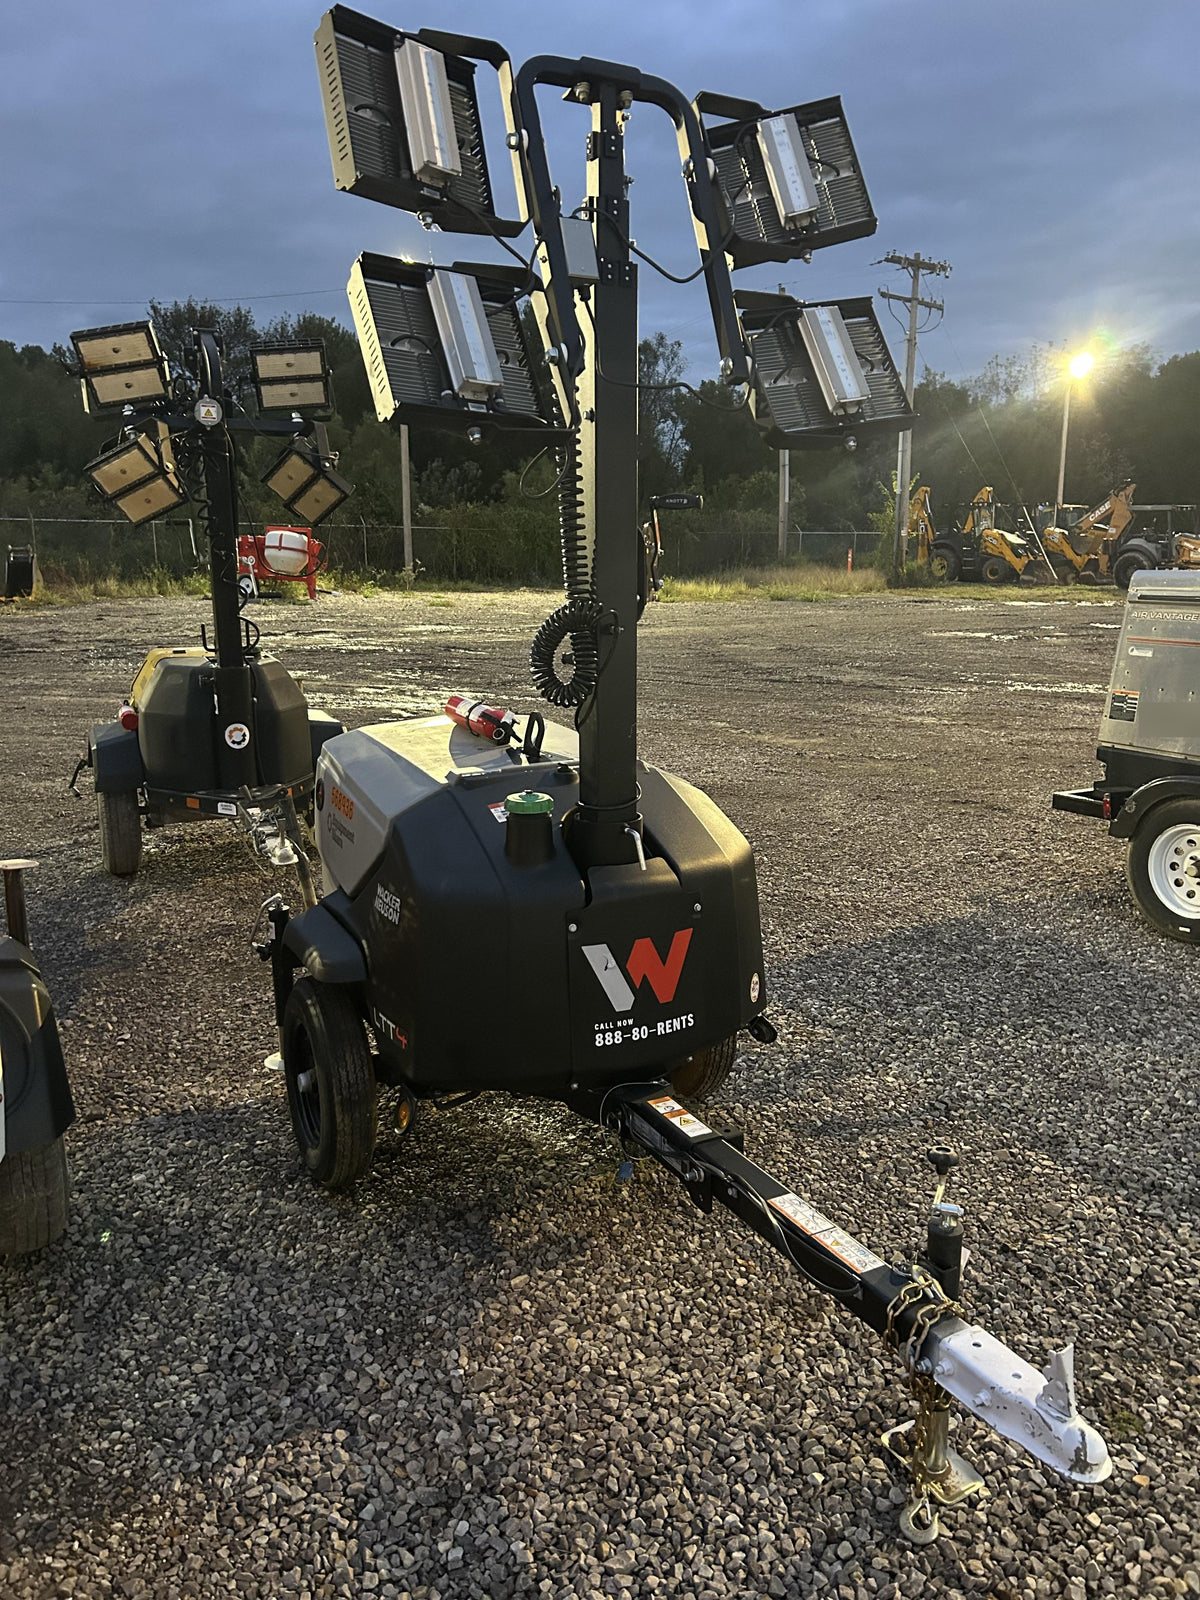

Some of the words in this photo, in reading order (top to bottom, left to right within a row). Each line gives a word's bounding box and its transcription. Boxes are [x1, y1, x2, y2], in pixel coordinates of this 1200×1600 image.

[1089, 500, 1112, 522] CASE
[1150, 611, 1199, 621] VANTAGE
[374, 895, 400, 925] NEUSON
[377, 882, 401, 913] WACKER
[373, 1006, 408, 1050] LTT4
[594, 1021, 615, 1031] CALL
[616, 1017, 635, 1028] NOW
[594, 1012, 695, 1048] 888-80-RENTS
